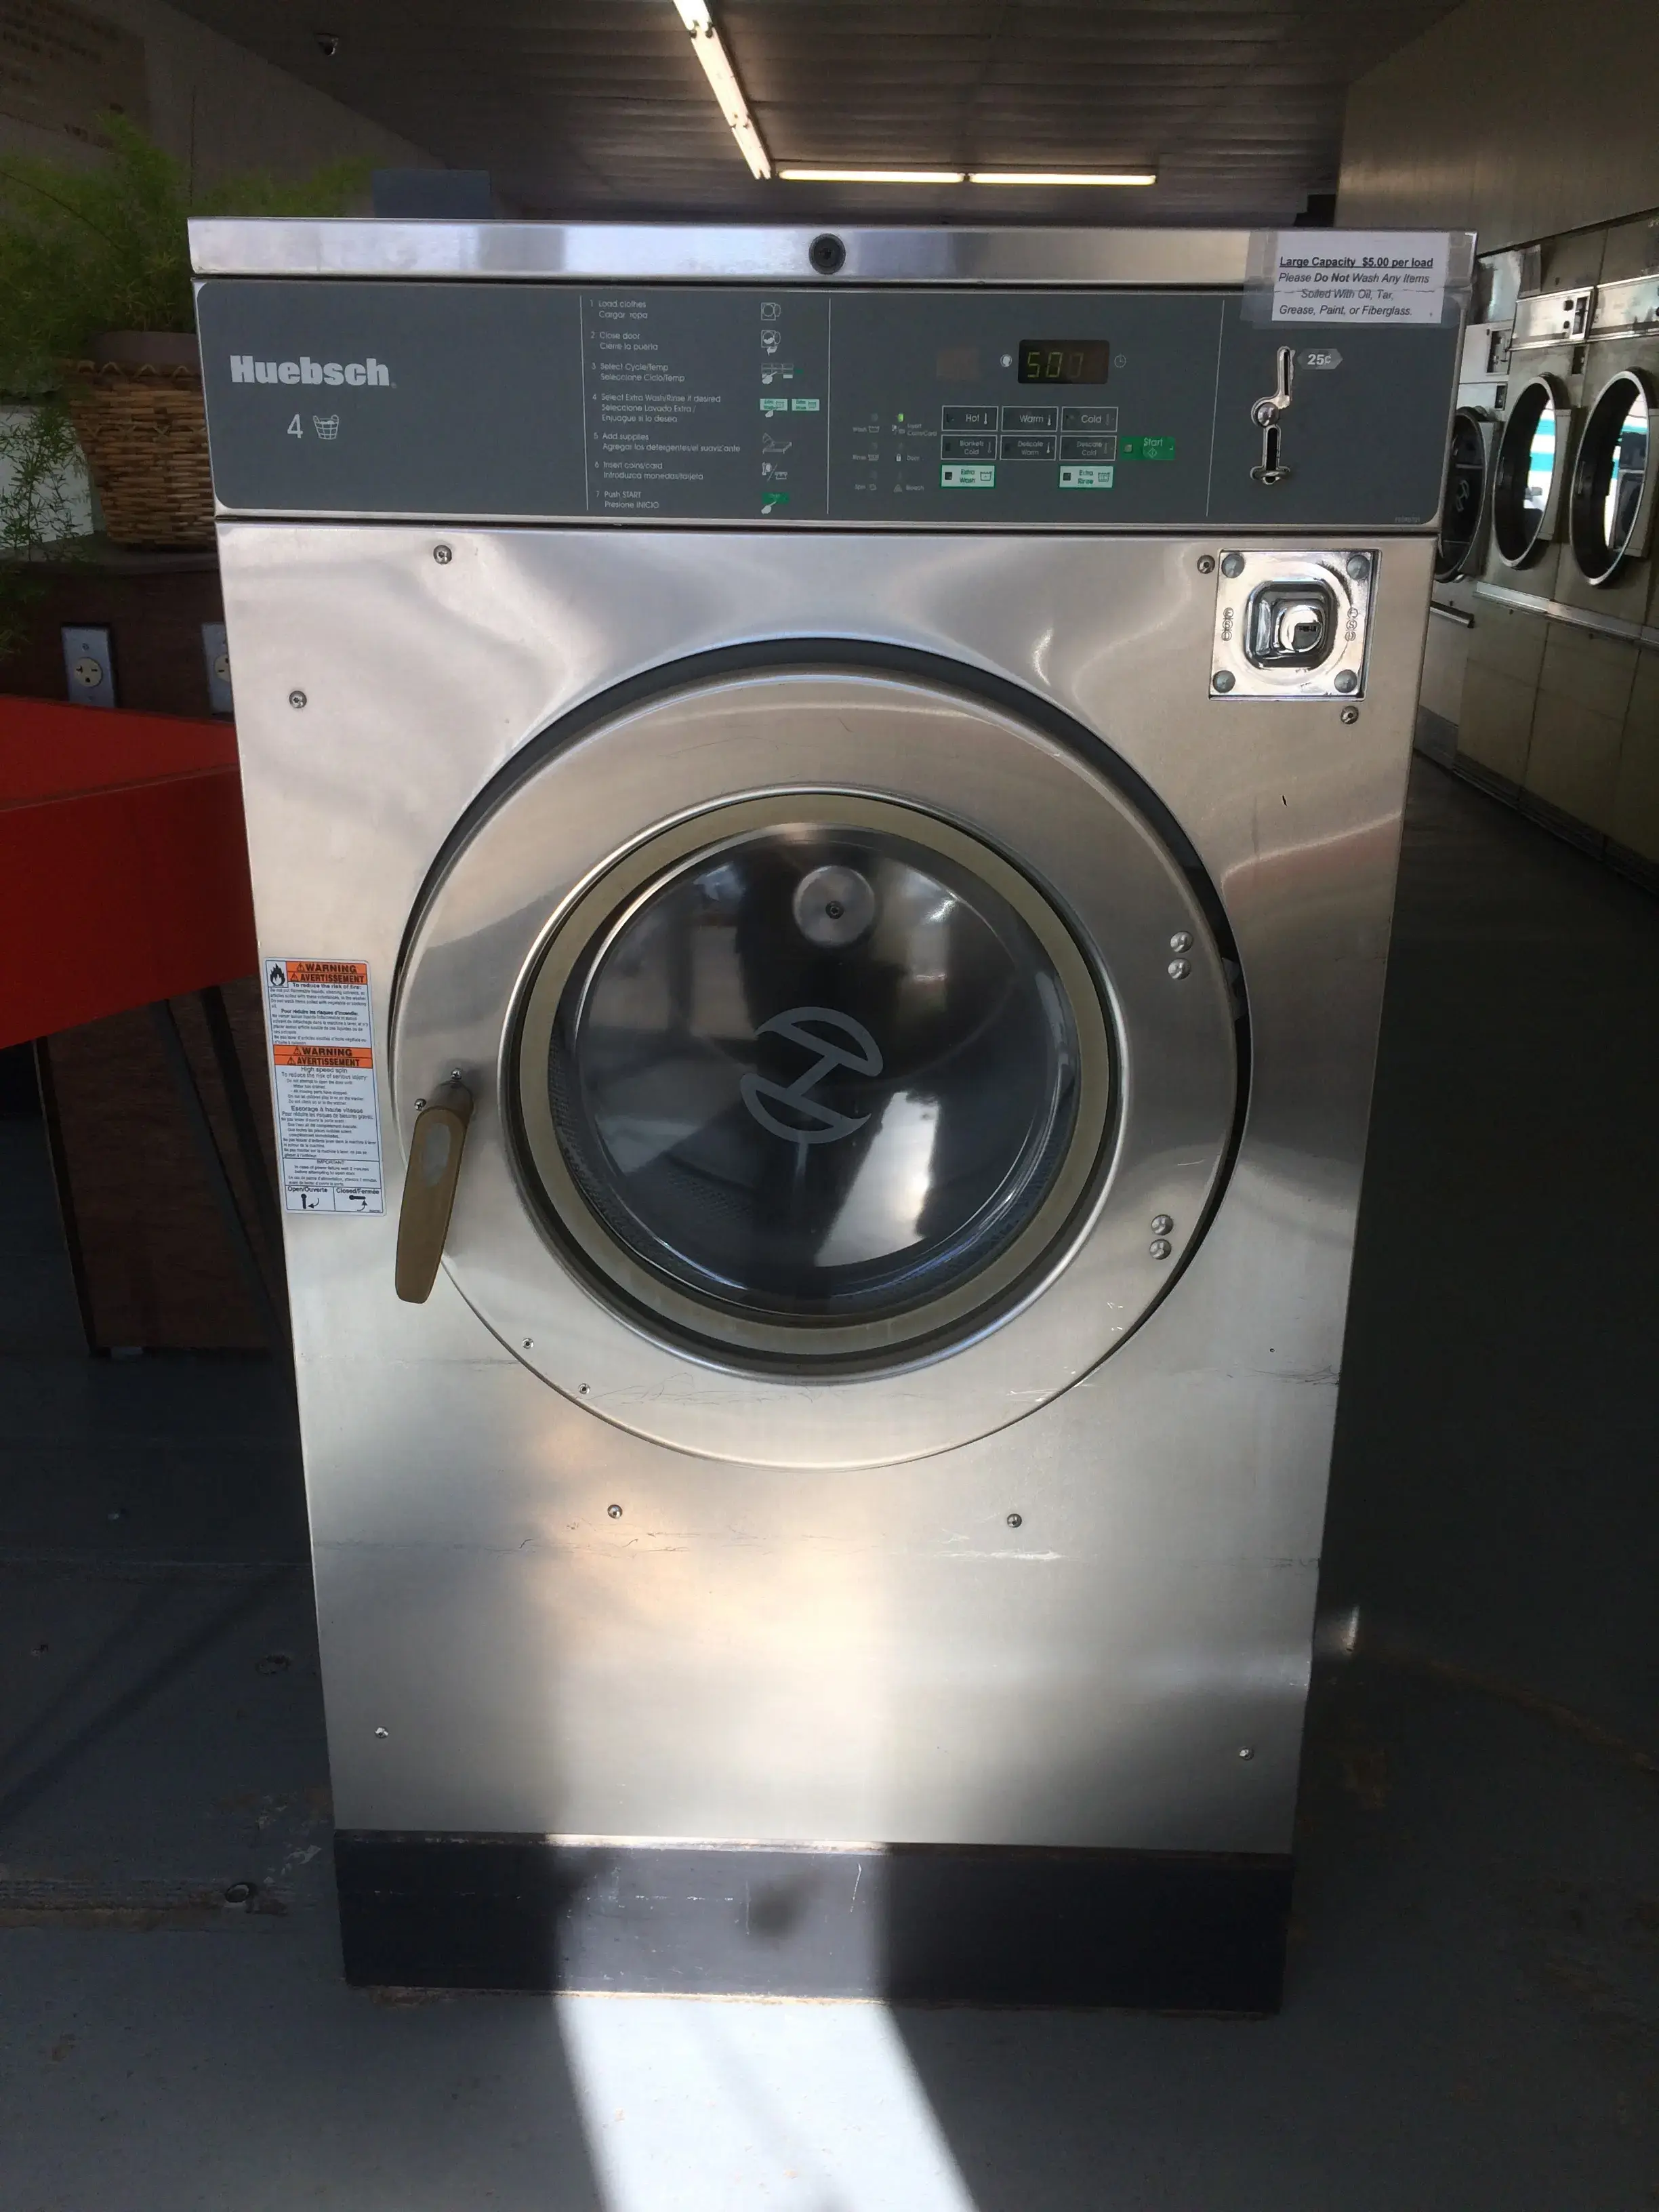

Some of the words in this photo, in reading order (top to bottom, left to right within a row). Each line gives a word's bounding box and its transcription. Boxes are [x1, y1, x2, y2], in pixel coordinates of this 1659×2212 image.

[1279, 256, 1309, 268] Large
[1311, 257, 1355, 268] Capacity
[1362, 257, 1389, 267] $5.00
[1391, 259, 1409, 268] per
[1411, 258, 1433, 267] load
[1279, 272, 1311, 283] Please
[1314, 273, 1330, 283] Do
[1331, 273, 1350, 283] Not
[1352, 273, 1380, 283] Wash
[1381, 274, 1401, 285] Any
[1403, 274, 1430, 283] Items
[1300, 289, 1331, 299] Soiled
[1334, 289, 1355, 299] With
[1357, 289, 1373, 300] Oil,
[1377, 289, 1394, 300] Tar,
[598, 300, 618, 308] Load
[619, 300, 647, 308] clothes
[598, 310, 626, 320] Cargar
[630, 312, 648, 320] ropa
[1279, 305, 1316, 316] Grease,
[1349, 307, 1360, 315] or
[1361, 306, 1412, 317] Fiberglass.
[599, 331, 621, 340] Close
[600, 342, 622, 350] Cierre
[623, 342, 632, 350] la
[1307, 354, 1332, 366] 25¢
[230, 355, 390, 386] Huebsch
[625, 363, 669, 372] Cycle/Temp
[600, 373, 642, 382] Seleccione
[644, 373, 685, 382] Ciclo/Temp
[601, 393, 623, 401] Select
[626, 394, 643, 402] Extra
[644, 394, 686, 403] Wash/Rinse
[693, 395, 721, 403] desired
[601, 404, 642, 412] Seleccione
[644, 405, 672, 413] Lavado
[602, 414, 636, 424] Enjuague
[966, 414, 980, 422] Hot
[1019, 415, 1044, 423] Warm
[1081, 415, 1102, 423] Cold
[287, 413, 303, 438] 4
[619, 433, 649, 442] supplies
[1143, 437, 1164, 447] Start
[602, 443, 632, 453] Agregar
[624, 462, 663, 470] coins/card
[603, 471, 642, 479] Introduzca
[304, 963, 357, 973] WARNING
[300, 974, 365, 983] AVERTISSEMENT
[303, 1047, 352, 1057] WARNING
[297, 1057, 360, 1067] AVERTISSEMENT
